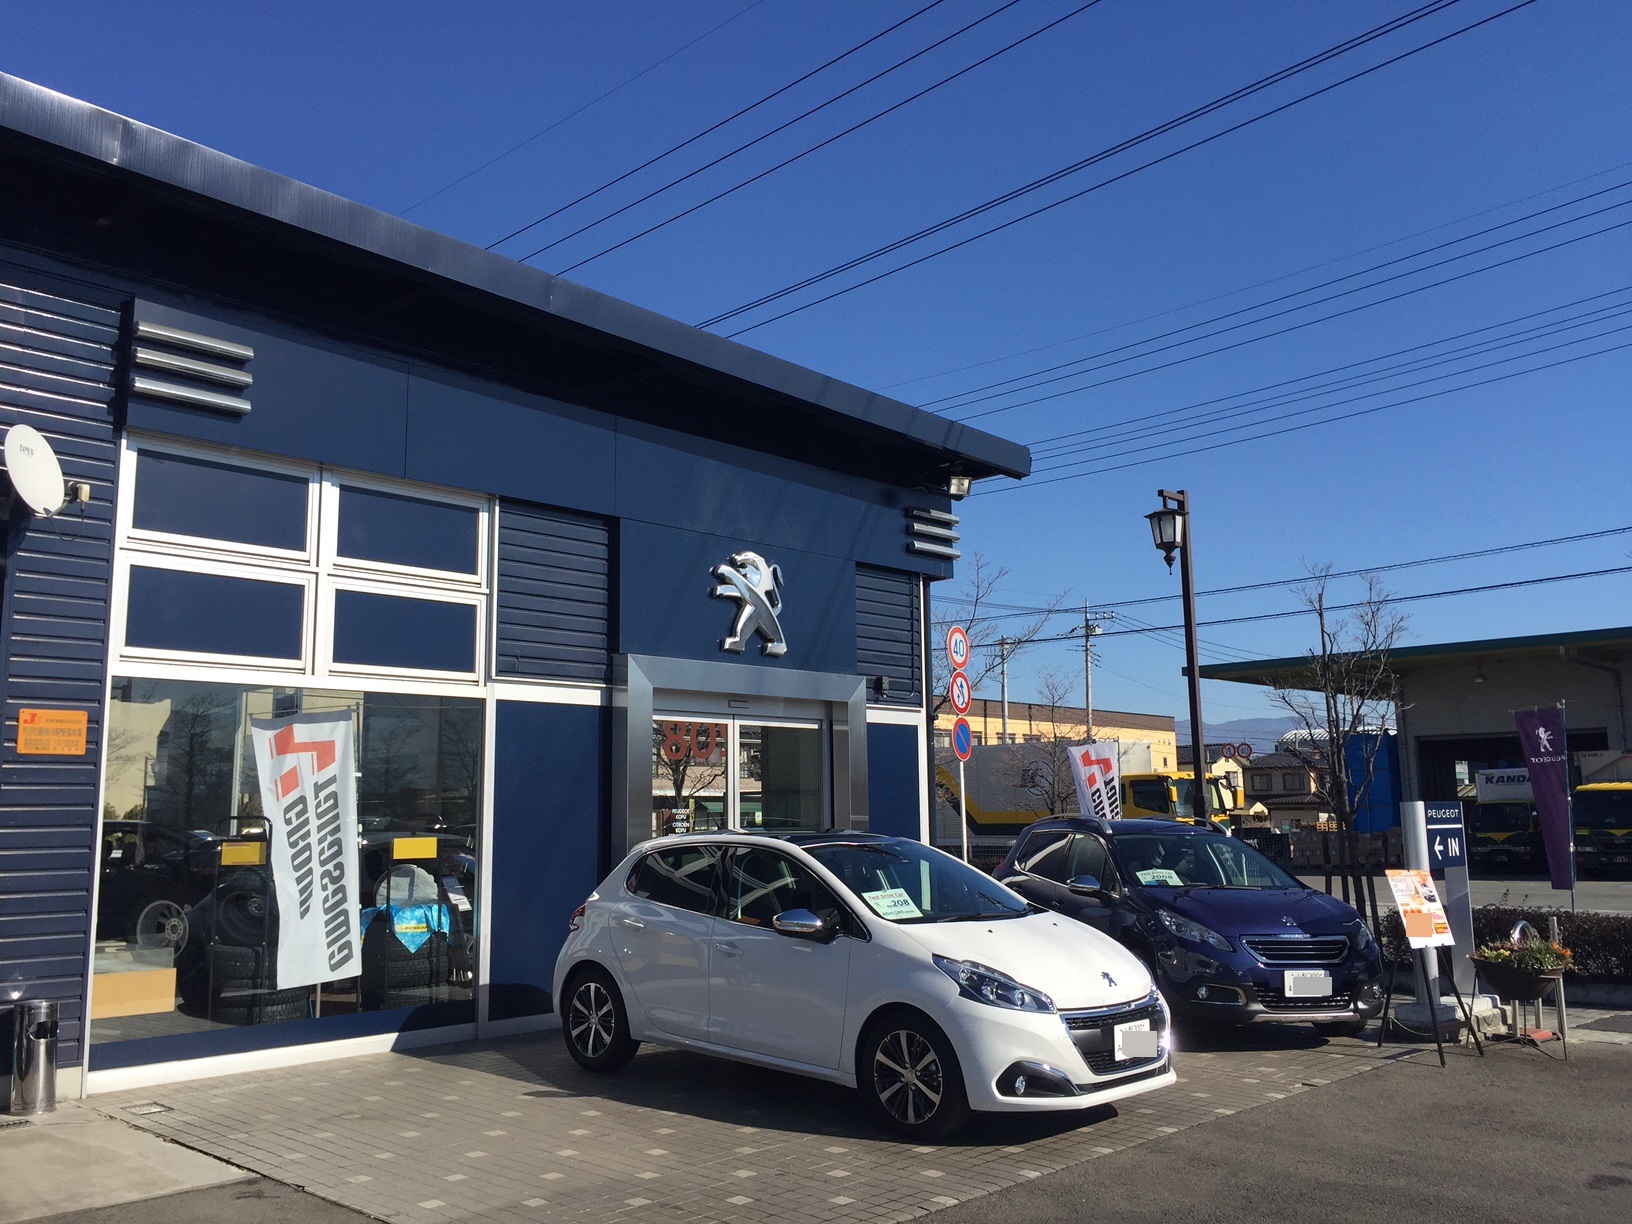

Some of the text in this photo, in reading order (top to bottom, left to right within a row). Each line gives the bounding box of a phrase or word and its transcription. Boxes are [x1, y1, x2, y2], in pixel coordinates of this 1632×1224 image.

[19, 444, 35, 456] DMS
[953, 638, 965, 657] 40
[1240, 746, 1250, 756] 40
[1427, 809, 1459, 818] PEUGEOT
[1447, 837, 1460, 857] IN
[890, 899, 910, 907] 208
